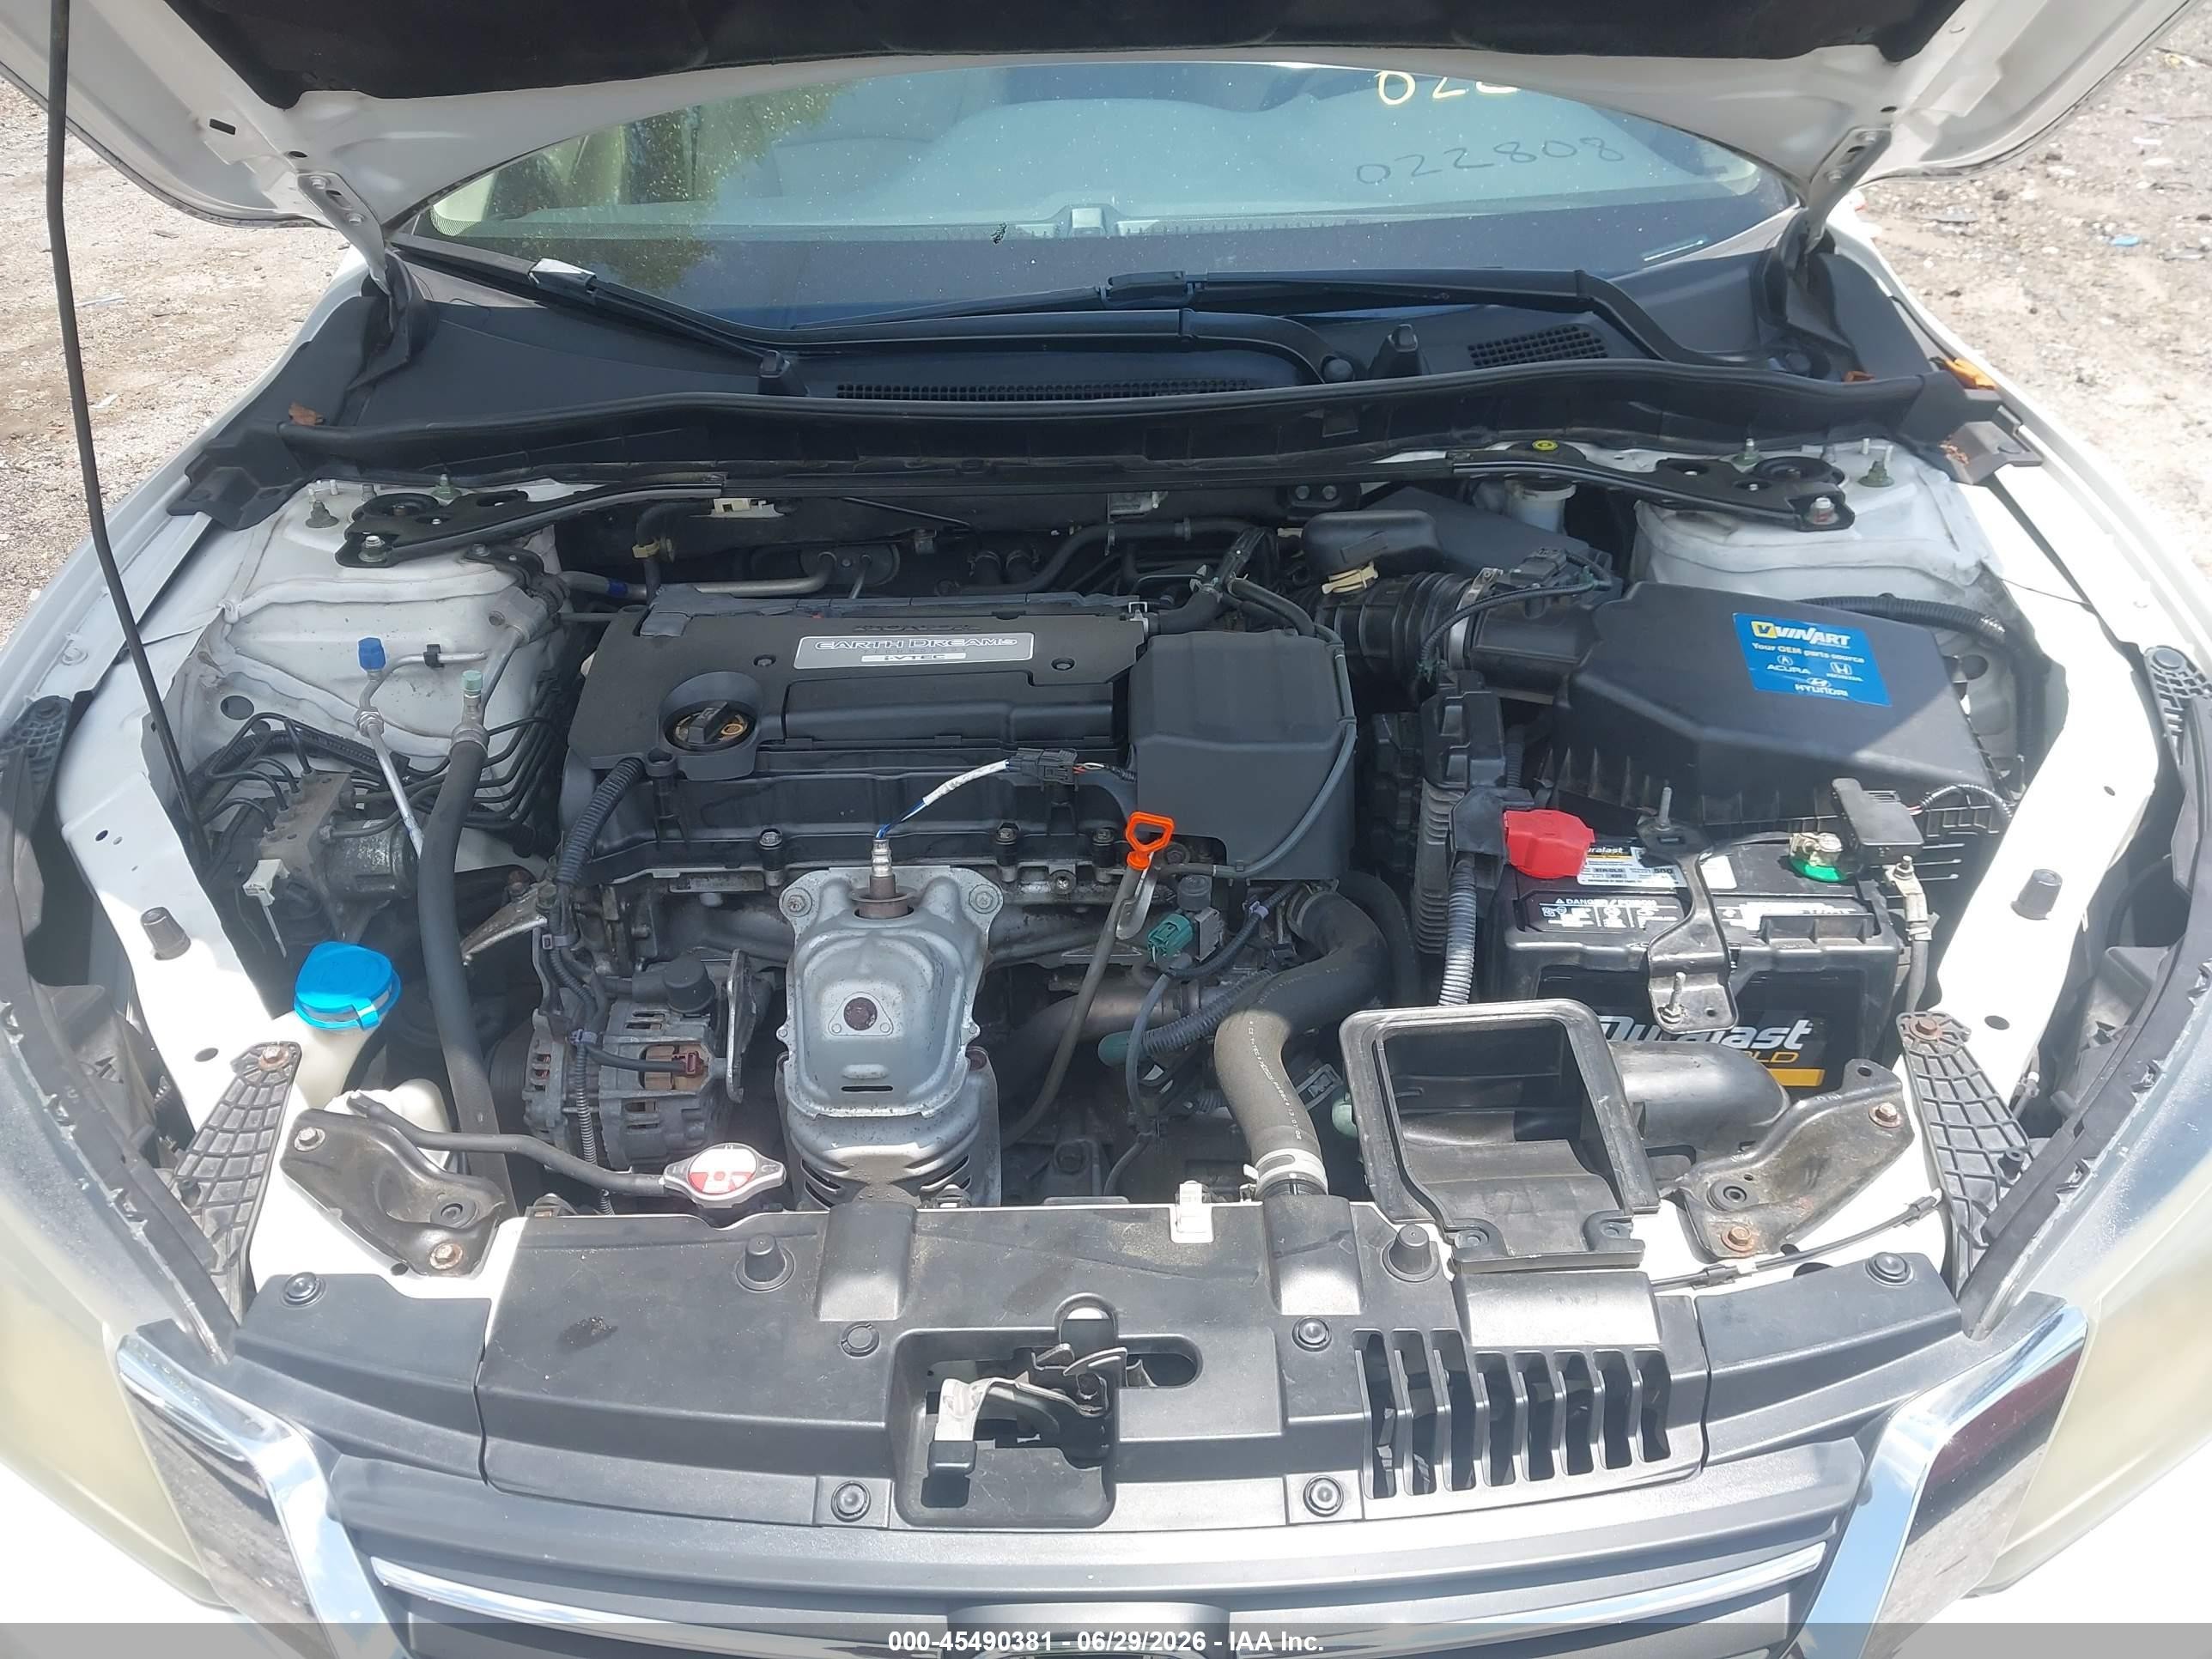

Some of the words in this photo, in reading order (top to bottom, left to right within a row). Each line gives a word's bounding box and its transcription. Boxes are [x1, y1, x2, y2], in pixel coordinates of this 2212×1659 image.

[1355, 137, 1625, 185] 022808
[816, 640, 902, 650] EARTH
[908, 638, 1018, 647] DREAMS
[1752, 642, 1777, 651] Your
[1766, 664, 1812, 674] ACURA
[1794, 684, 1849, 696] HYUNDAI
